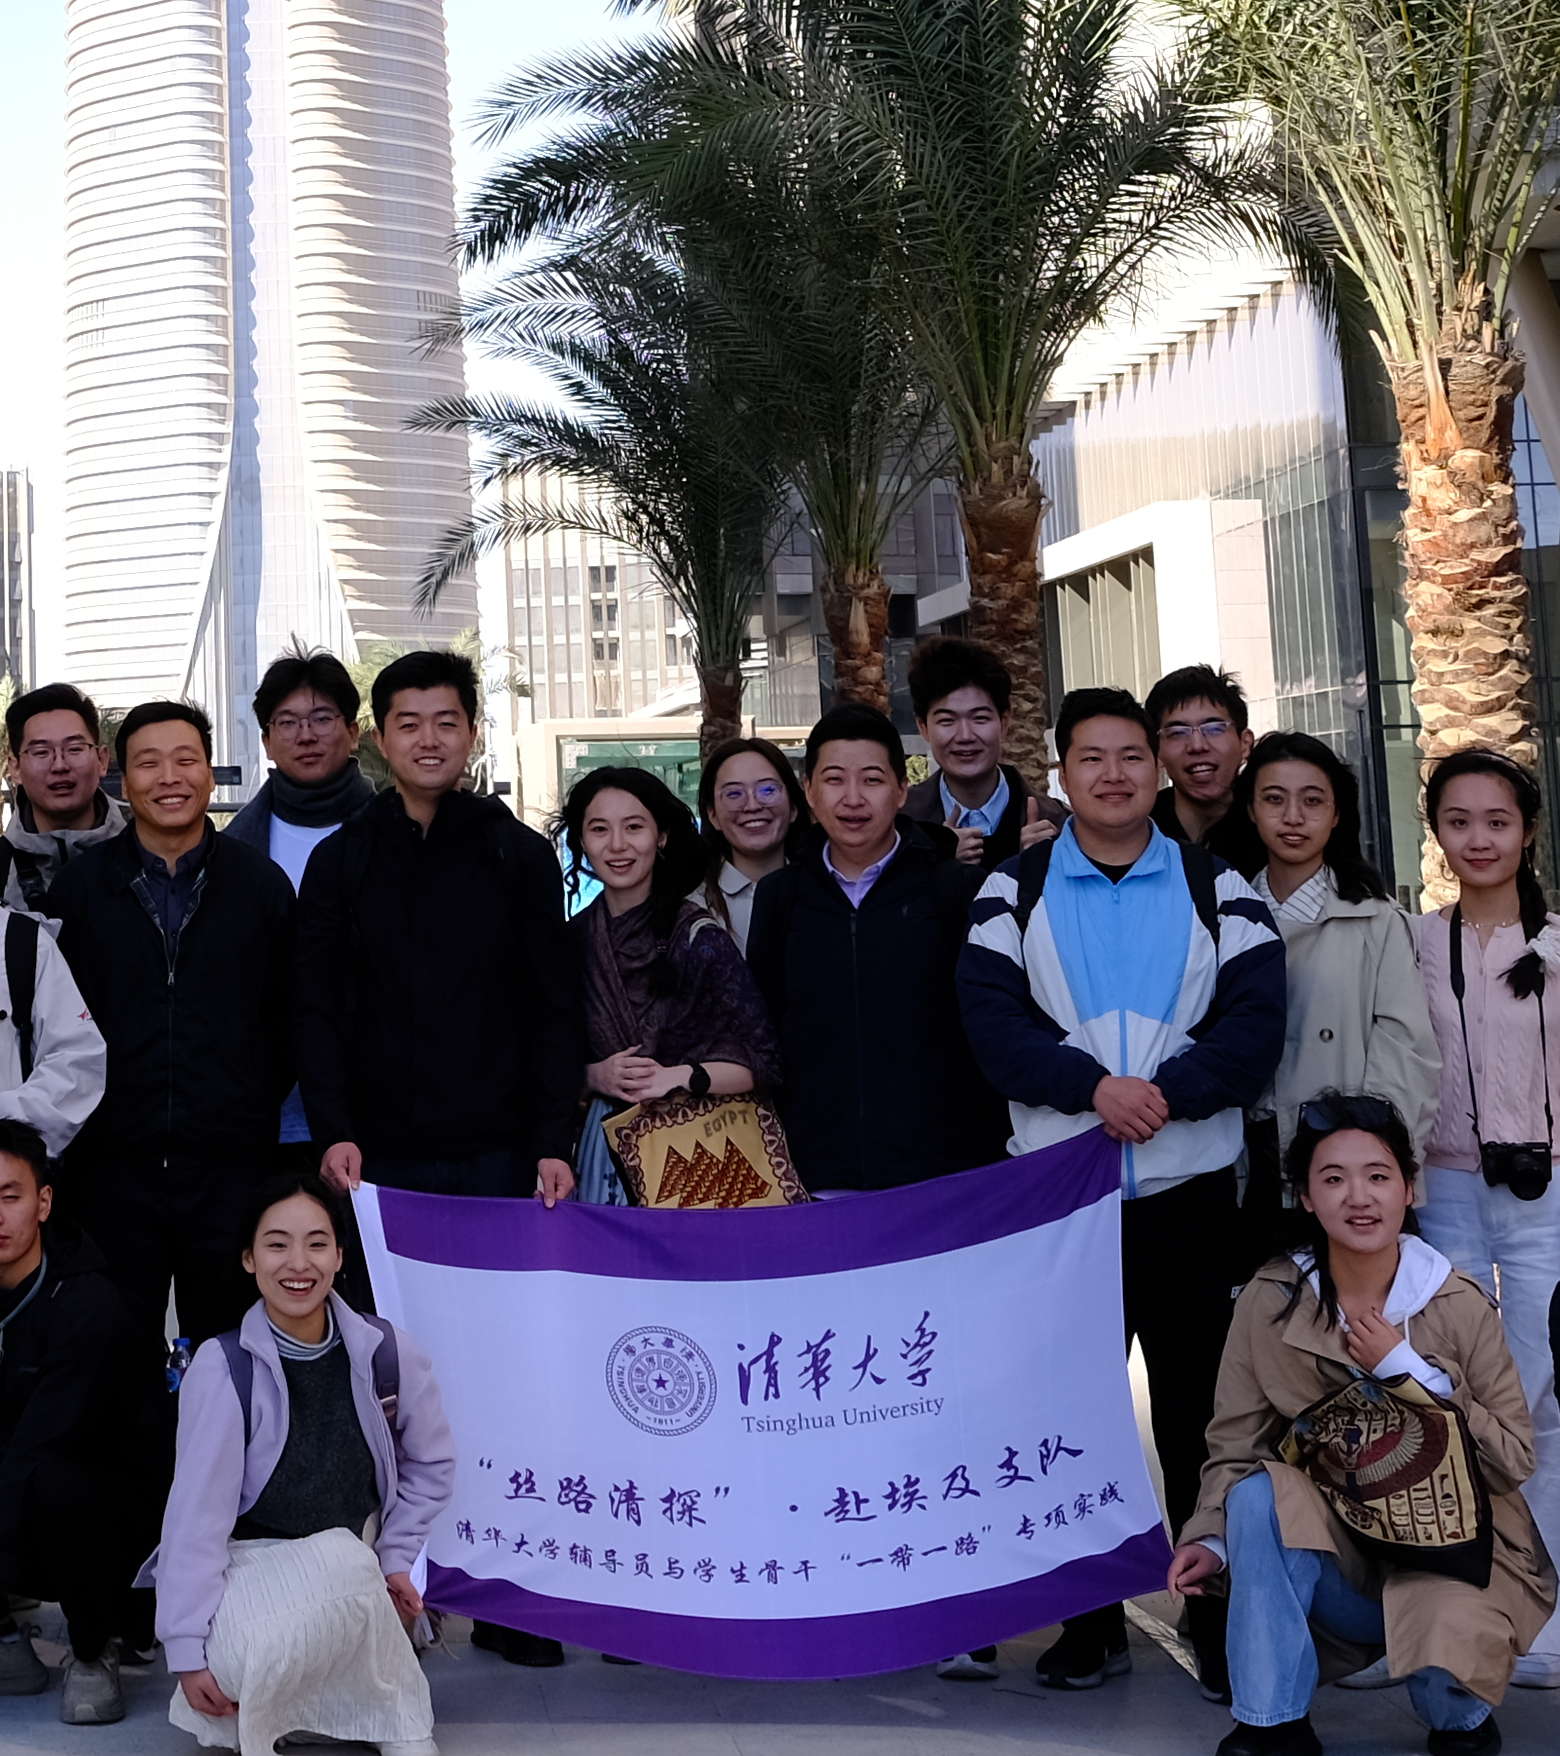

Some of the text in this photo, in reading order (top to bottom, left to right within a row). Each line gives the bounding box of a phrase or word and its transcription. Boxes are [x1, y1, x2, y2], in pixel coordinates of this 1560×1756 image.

[703, 1108, 749, 1138] EGYPT
[740, 1396, 946, 1437] Tsinghua University
